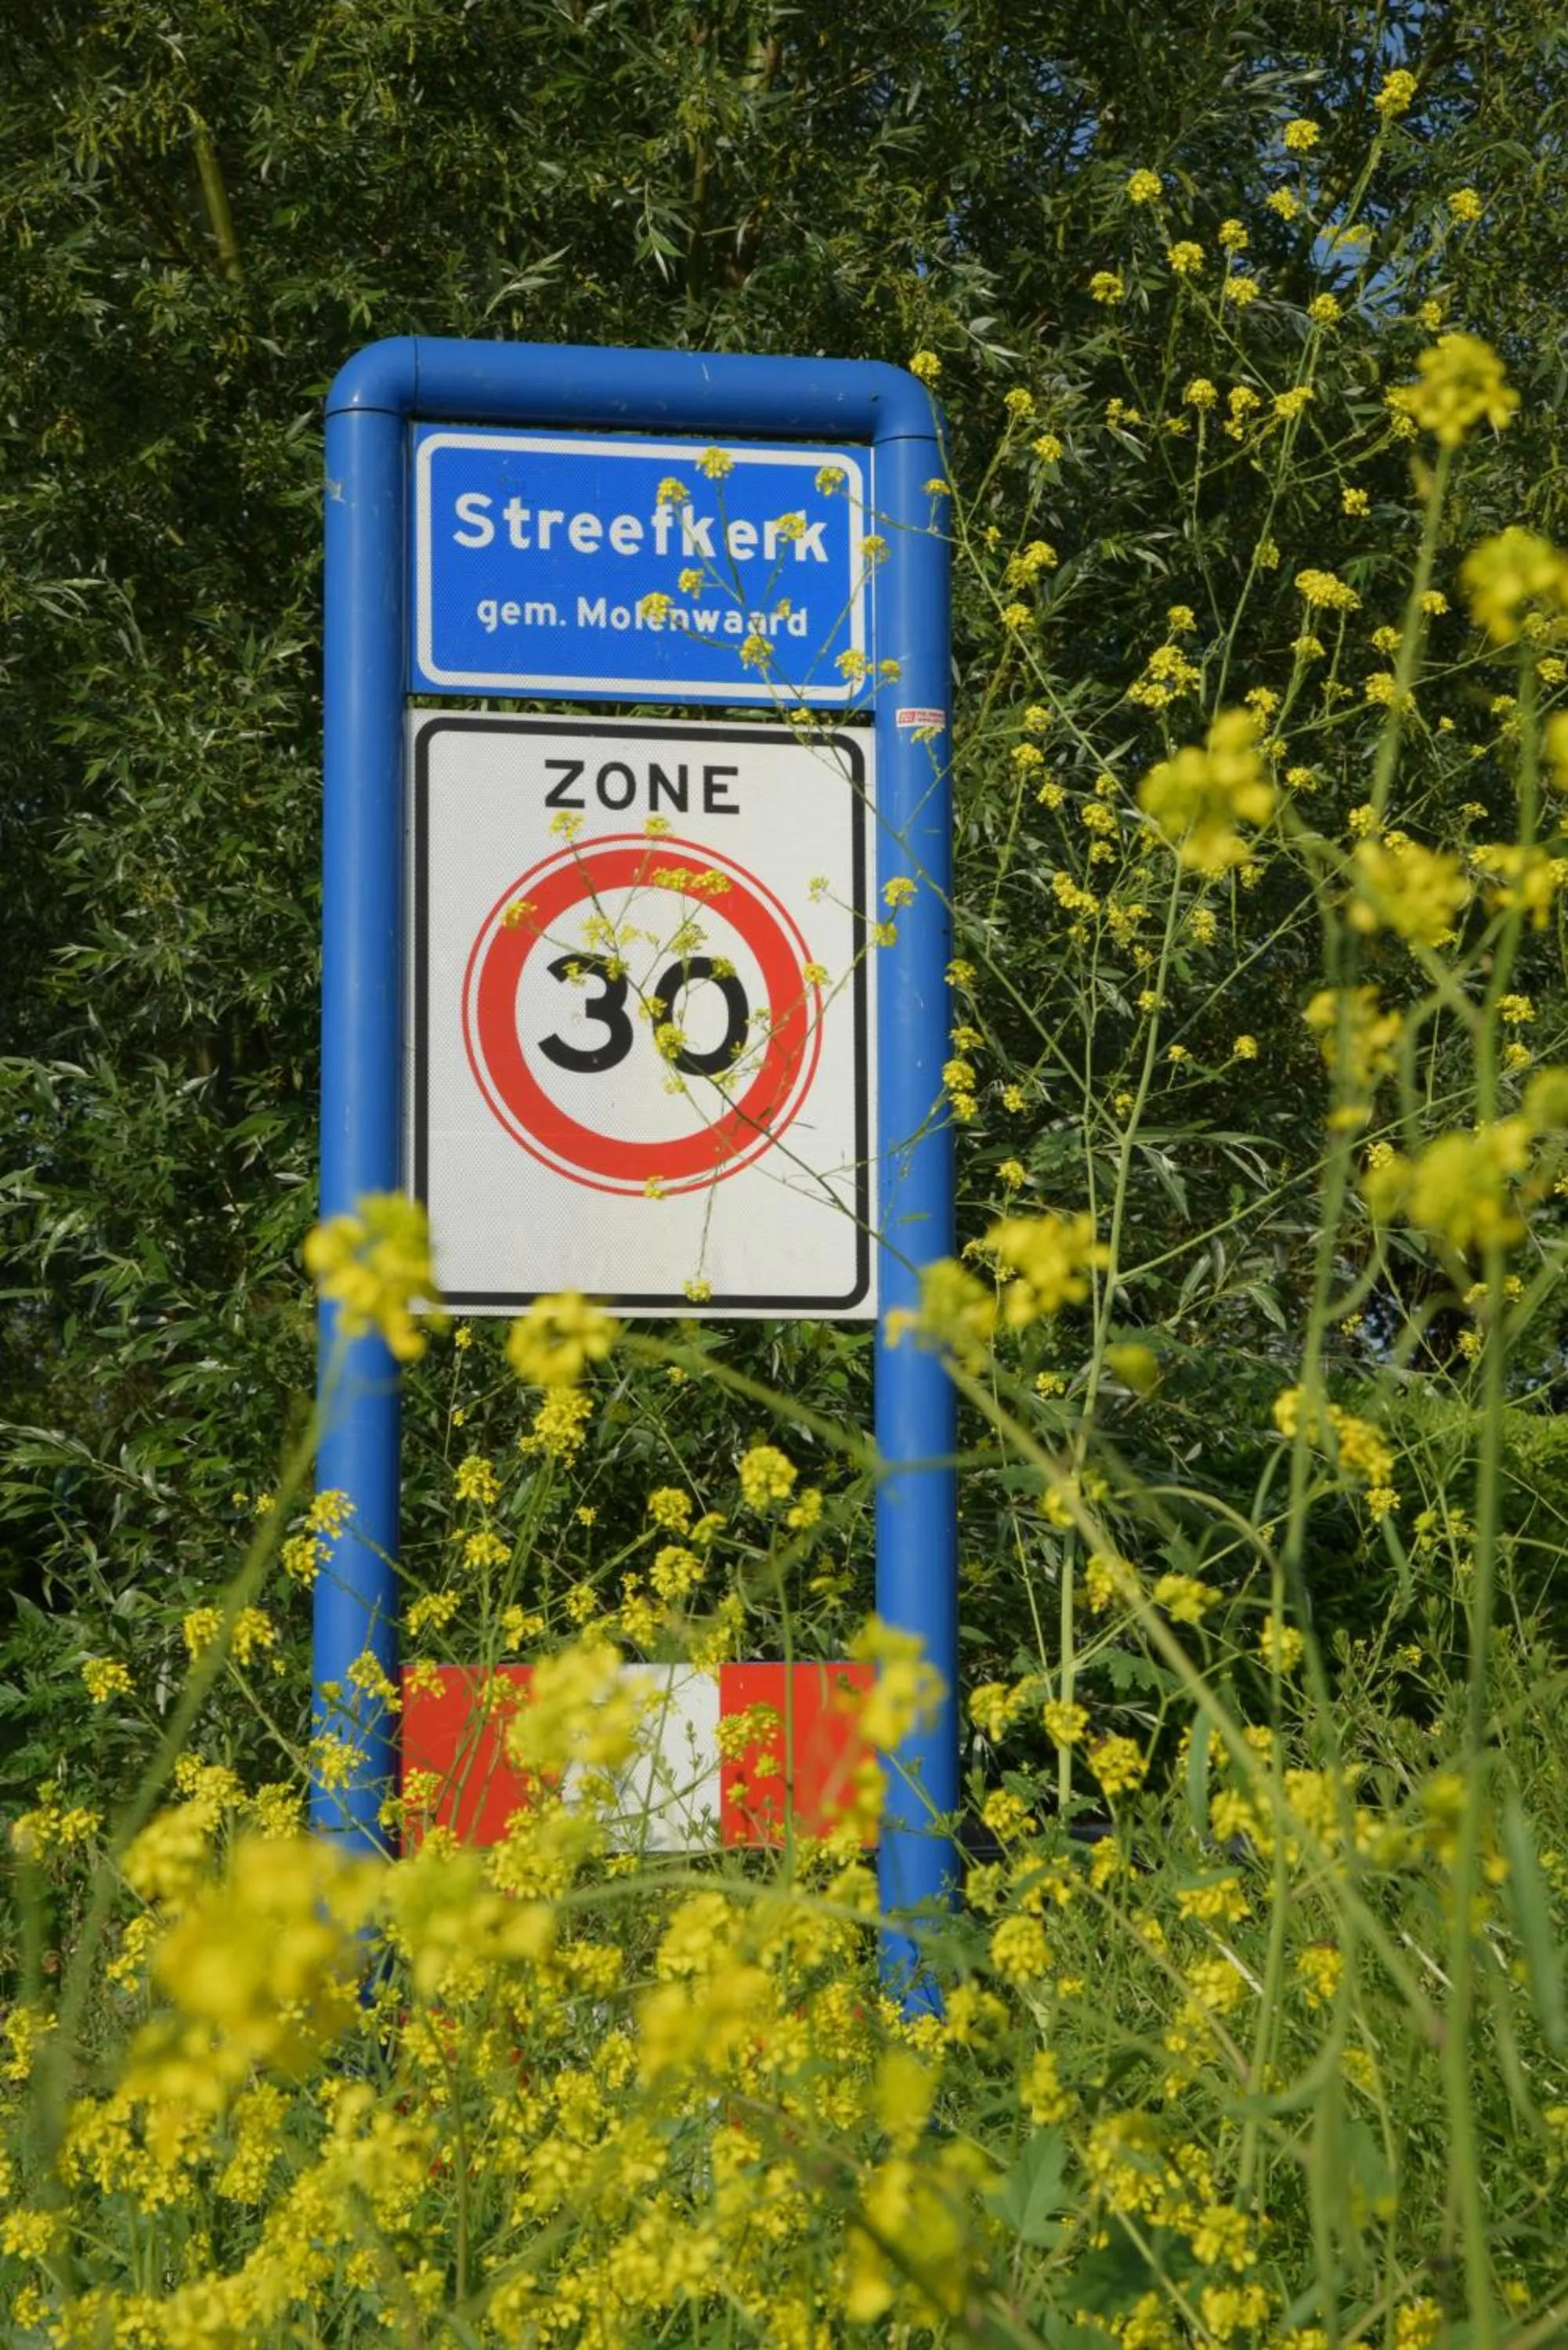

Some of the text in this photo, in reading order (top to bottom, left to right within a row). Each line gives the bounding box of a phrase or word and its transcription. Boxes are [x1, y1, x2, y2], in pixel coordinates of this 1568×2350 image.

[452, 492, 829, 562] Streefkerk
[476, 599, 567, 634] gem.
[544, 759, 740, 815] ZONE
[537, 952, 750, 1076] 30
